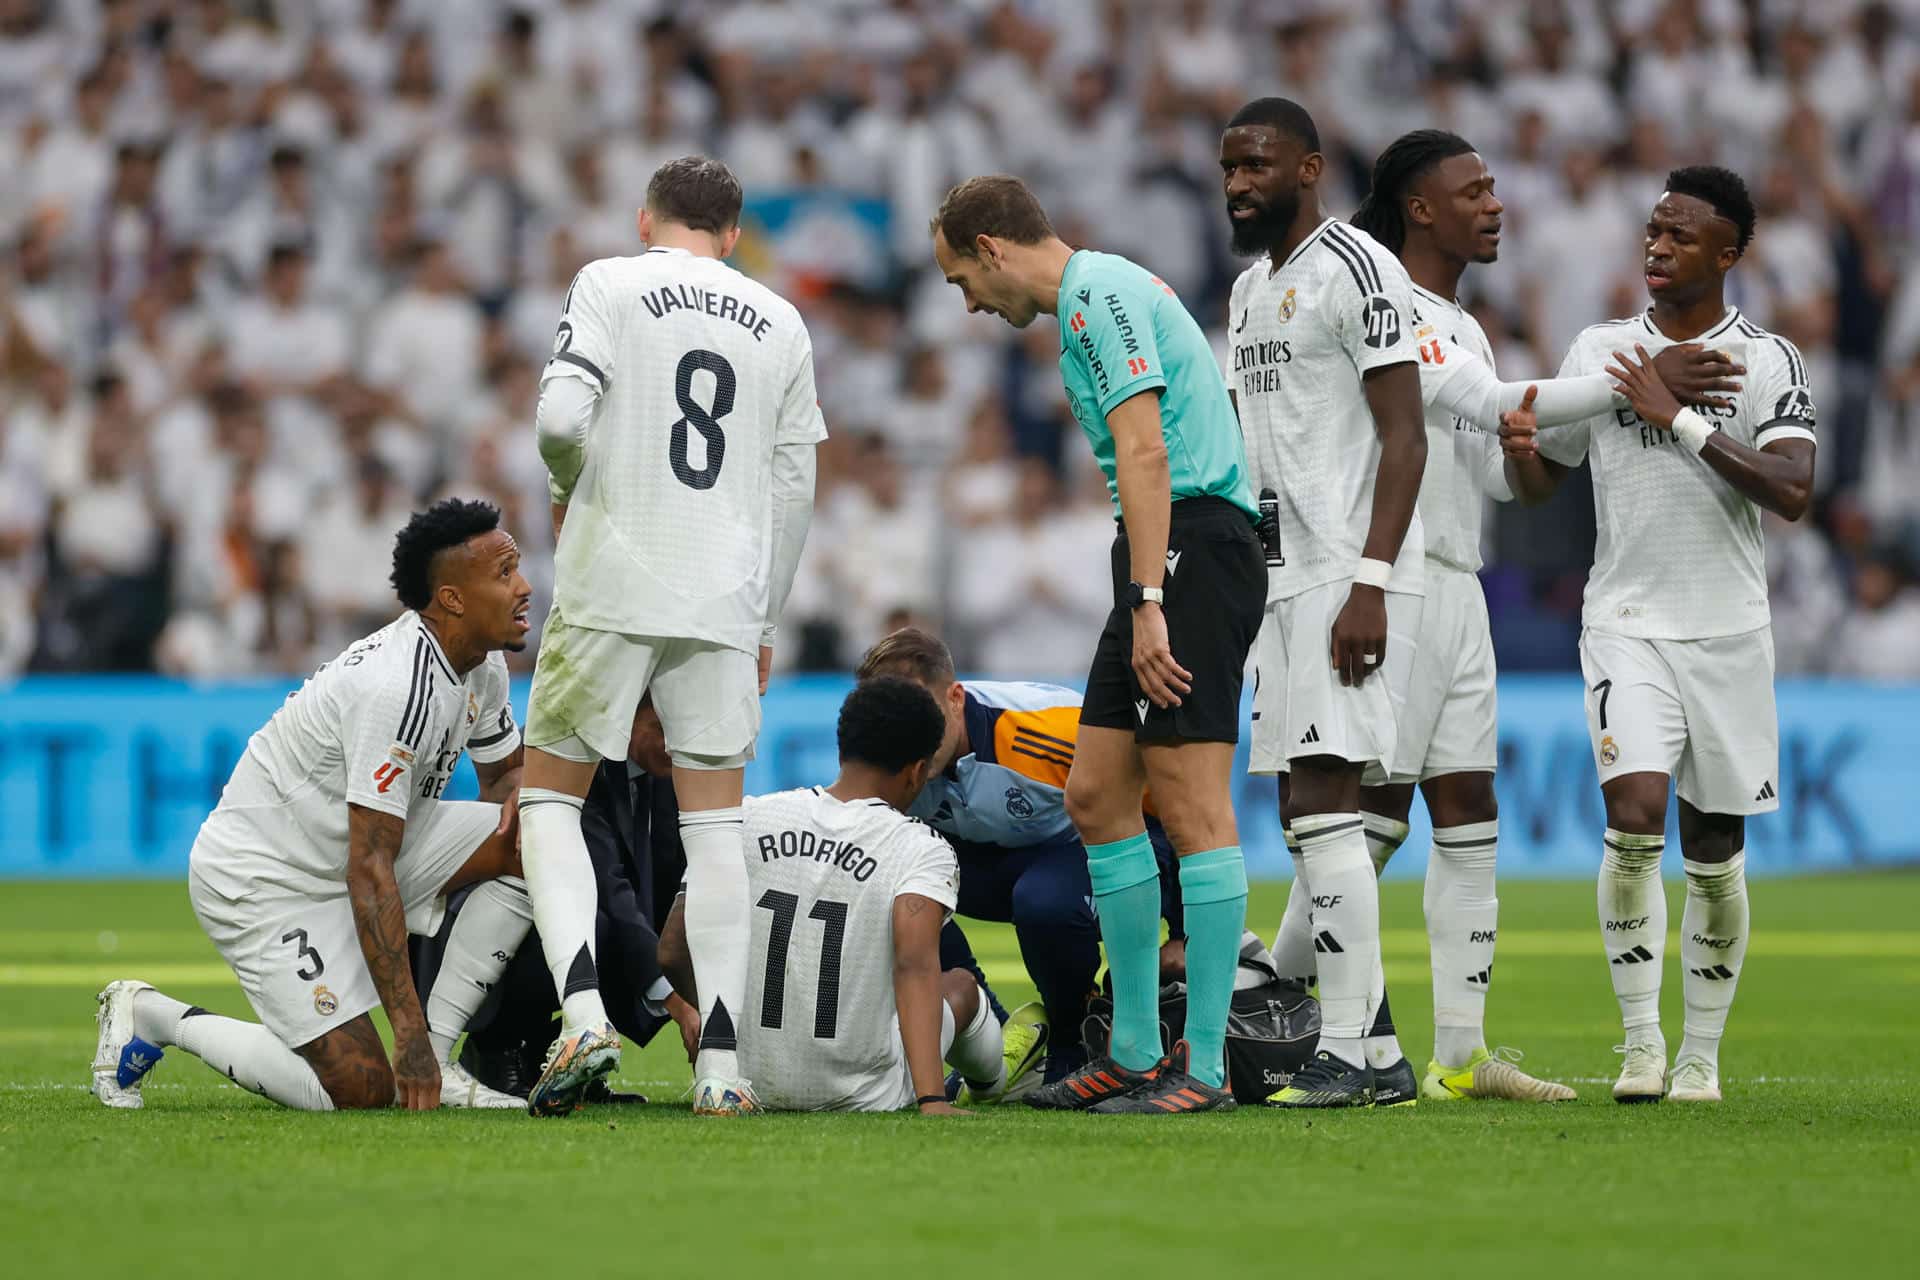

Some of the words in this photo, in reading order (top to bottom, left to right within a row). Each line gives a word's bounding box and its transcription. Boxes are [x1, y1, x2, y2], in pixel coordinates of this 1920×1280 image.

[641, 284, 772, 342] VALVERDE
[1103, 293, 1139, 354] WÜRTH
[1365, 298, 1398, 348] hp
[1080, 331, 1110, 396] WÜRTH
[669, 350, 736, 490] 8
[1593, 678, 1612, 730] 7
[758, 831, 877, 882] RODRYGO
[1312, 895, 1342, 908] MCF
[1606, 916, 1649, 931] RMCF
[282, 928, 324, 981] 3
[1470, 930, 1496, 943] RM
[1692, 934, 1738, 949] RMCF
[756, 889, 848, 1039] 11
